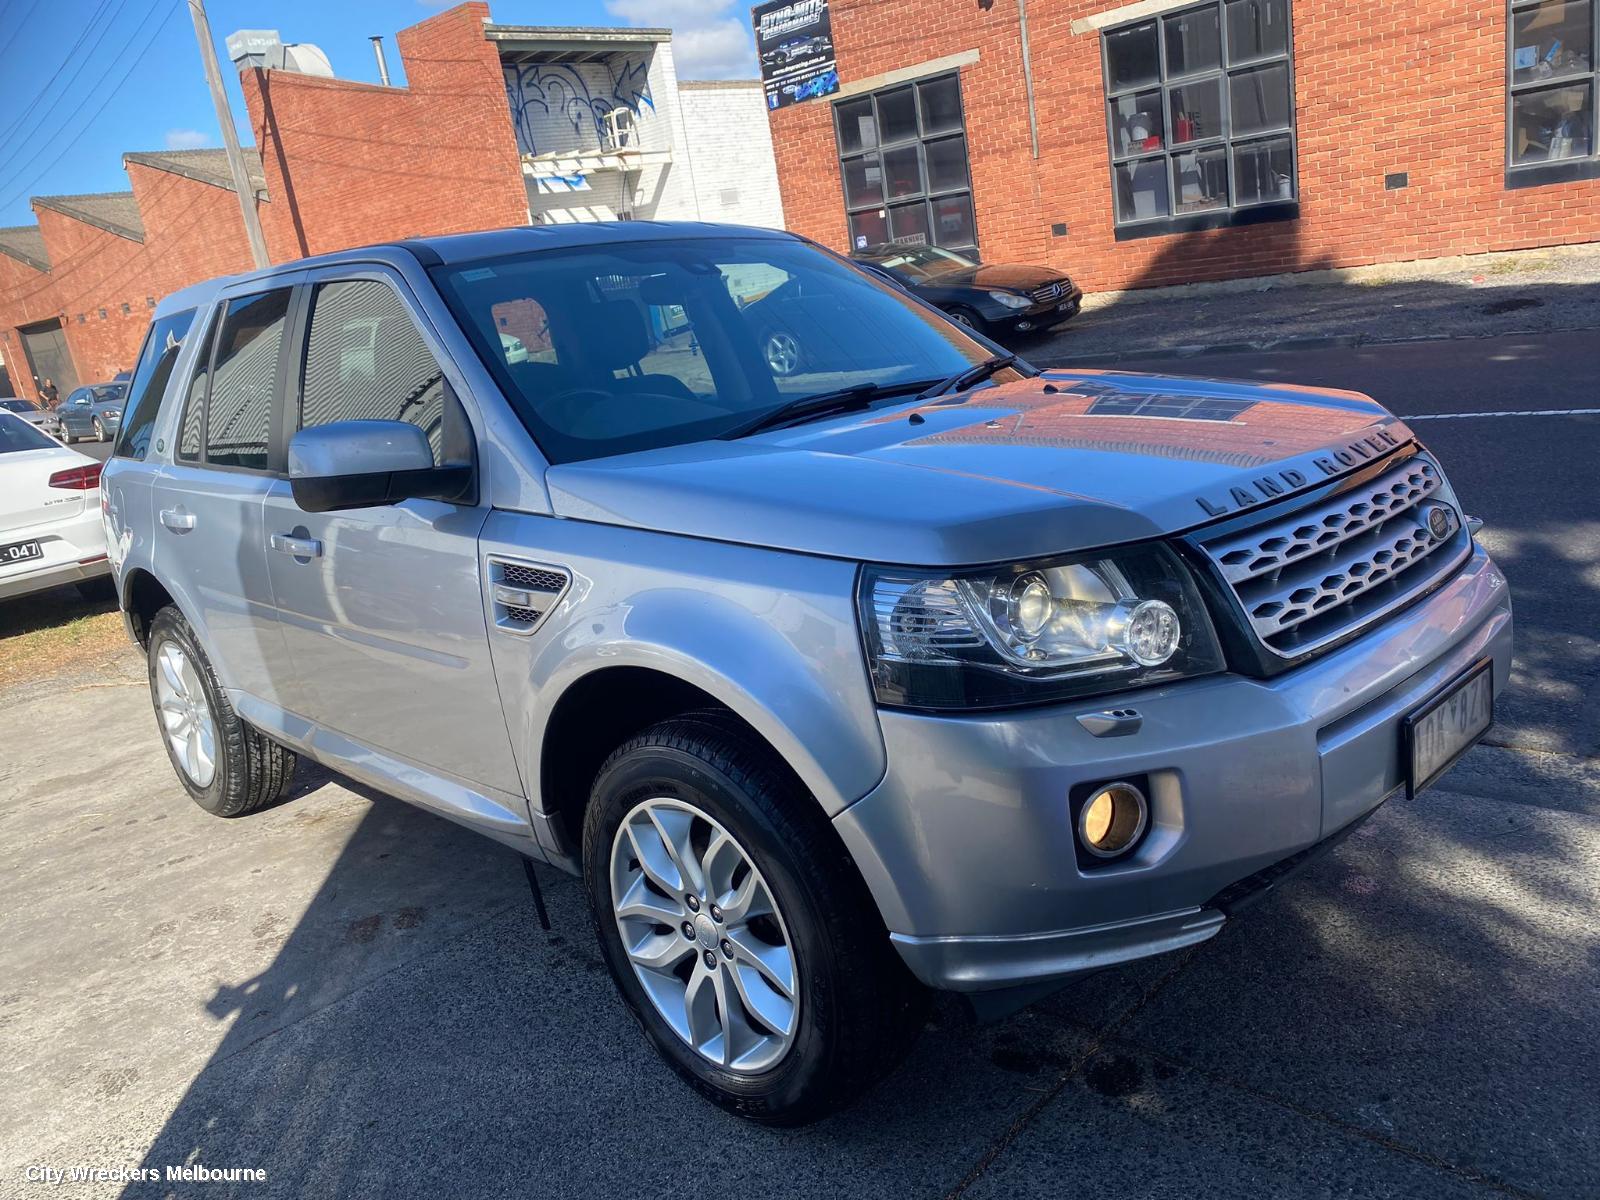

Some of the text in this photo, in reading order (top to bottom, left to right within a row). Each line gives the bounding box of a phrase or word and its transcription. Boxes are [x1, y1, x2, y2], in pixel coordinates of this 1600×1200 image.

[762, 0, 824, 29] DYNO-MITE
[764, 12, 819, 35] PERFORMANCE
[1194, 430, 1399, 516] LAND ROVER
